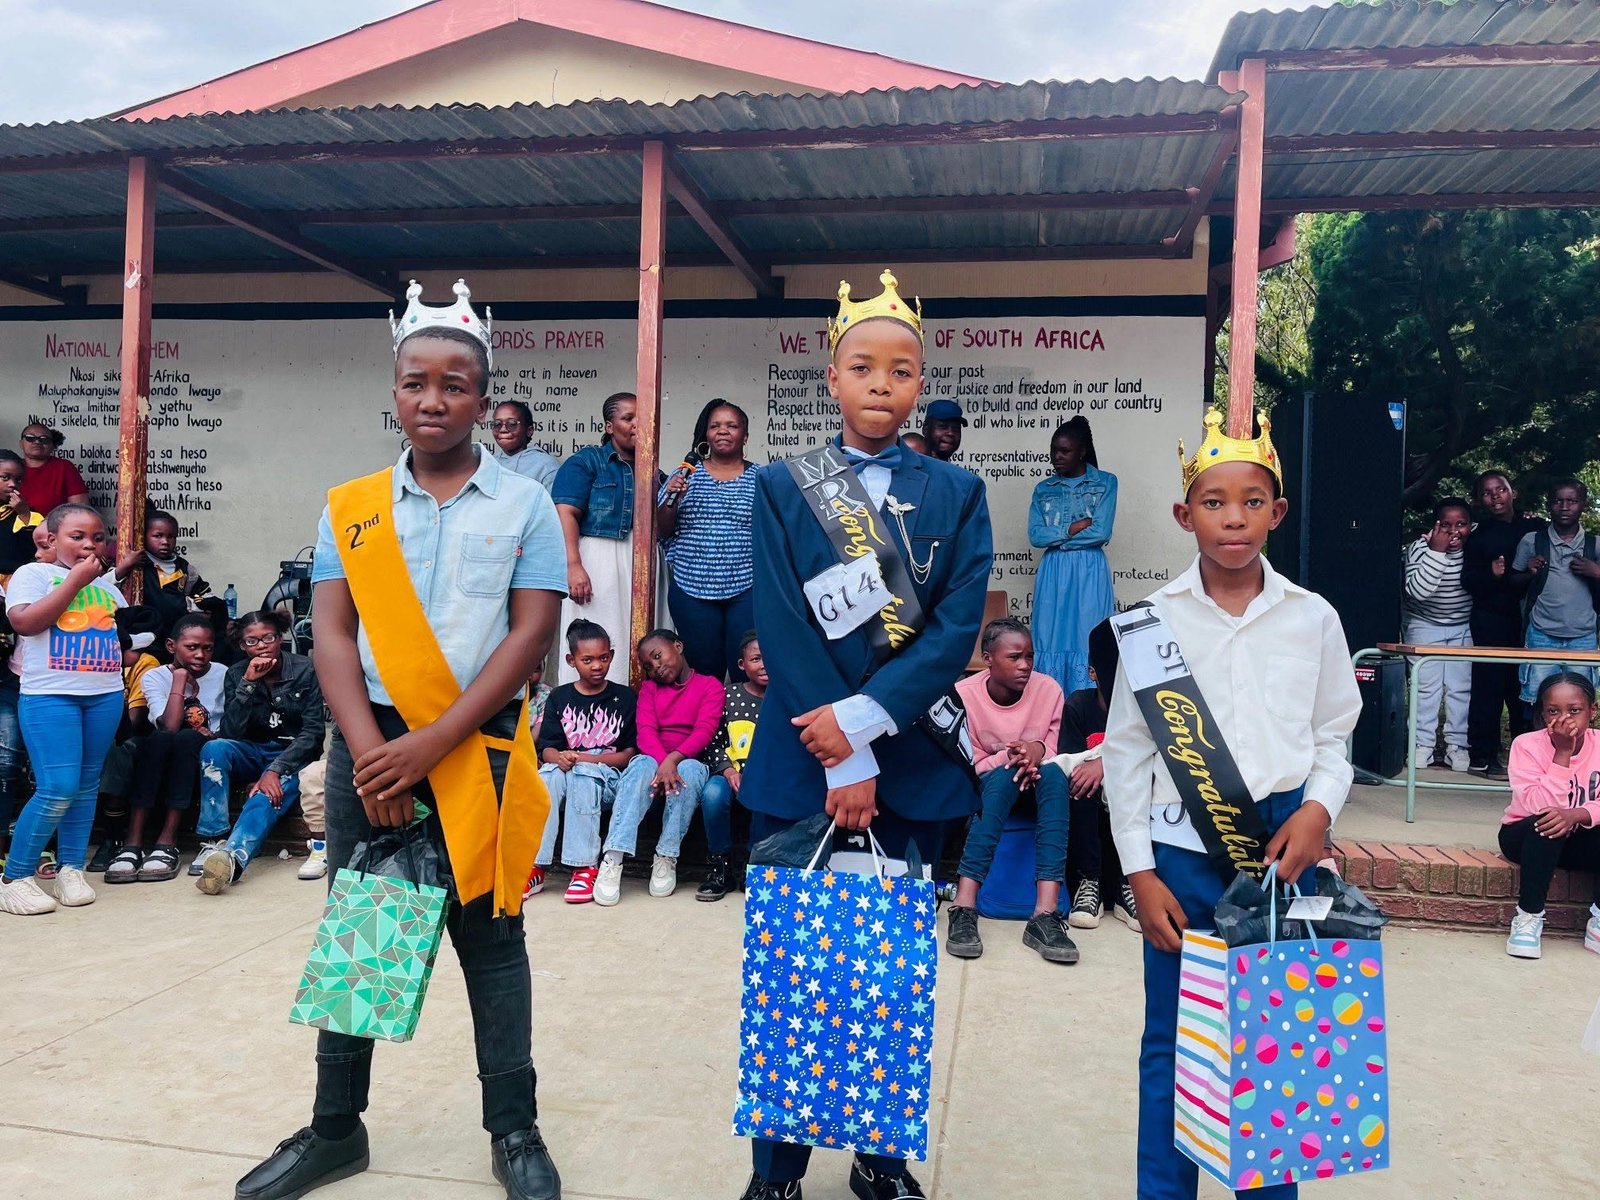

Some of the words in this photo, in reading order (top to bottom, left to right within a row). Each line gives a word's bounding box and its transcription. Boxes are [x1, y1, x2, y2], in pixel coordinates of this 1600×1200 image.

[45, 333, 111, 358] NATIONAL
[490, 328, 536, 350] ORD'S
[545, 330, 605, 349] PRAYER
[935, 329, 956, 349] OF
[962, 327, 1022, 349] SOUTH
[1034, 326, 1106, 352] AFRICA
[70, 366, 95, 382] Nkosi
[103, 369, 122, 382] sike
[519, 368, 536, 380] art
[542, 367, 551, 380] in
[559, 364, 597, 379] heaven
[768, 363, 825, 385] Recognise
[931, 366, 953, 378] our
[959, 364, 985, 384] past
[38, 383, 120, 400] Maluphakanyisw
[150, 384, 178, 397] ondo
[188, 383, 221, 401] lwayo
[493, 381, 507, 395] be
[513, 381, 533, 399] thy
[546, 385, 578, 397] name
[767, 383, 809, 399] Honour
[935, 380, 952, 395] for
[952, 383, 989, 399] justice
[993, 380, 1014, 395] and
[1019, 377, 1067, 395] freedom
[1073, 379, 1083, 394] in
[1087, 380, 1109, 394] our
[1114, 377, 1142, 394] land
[53, 400, 80, 414] Yizwa
[158, 399, 193, 415] yethu
[534, 401, 562, 412] come
[767, 399, 815, 419] Respect
[816, 399, 842, 416] thos
[966, 397, 979, 413] to
[982, 397, 1010, 413] build
[1015, 398, 1038, 412] and
[1043, 396, 1085, 414] develop
[1090, 399, 1109, 410] our
[1114, 394, 1163, 413] country
[187, 413, 223, 432] lwayo
[381, 411, 403, 434] Thy
[547, 419, 556, 432] it
[558, 419, 568, 432] is
[575, 418, 585, 432] in
[767, 417, 787, 431] And
[792, 417, 822, 431] believe
[973, 415, 987, 429] all
[990, 415, 1014, 429] who
[1017, 414, 1036, 429] live
[1040, 415, 1050, 429] in
[767, 433, 799, 447] United
[806, 433, 816, 446] in
[80, 444, 112, 460] boloka
[160, 448, 173, 460] sa
[180, 445, 208, 460] heso
[985, 465, 1026, 482] republic
[1029, 467, 1042, 477] so
[177, 480, 191, 491] sa
[196, 477, 223, 492] heso
[177, 493, 211, 511] Afrika
[345, 513, 380, 550] 2nd
[1112, 567, 1170, 585] protected
[1155, 689, 1264, 878] Congratulati
